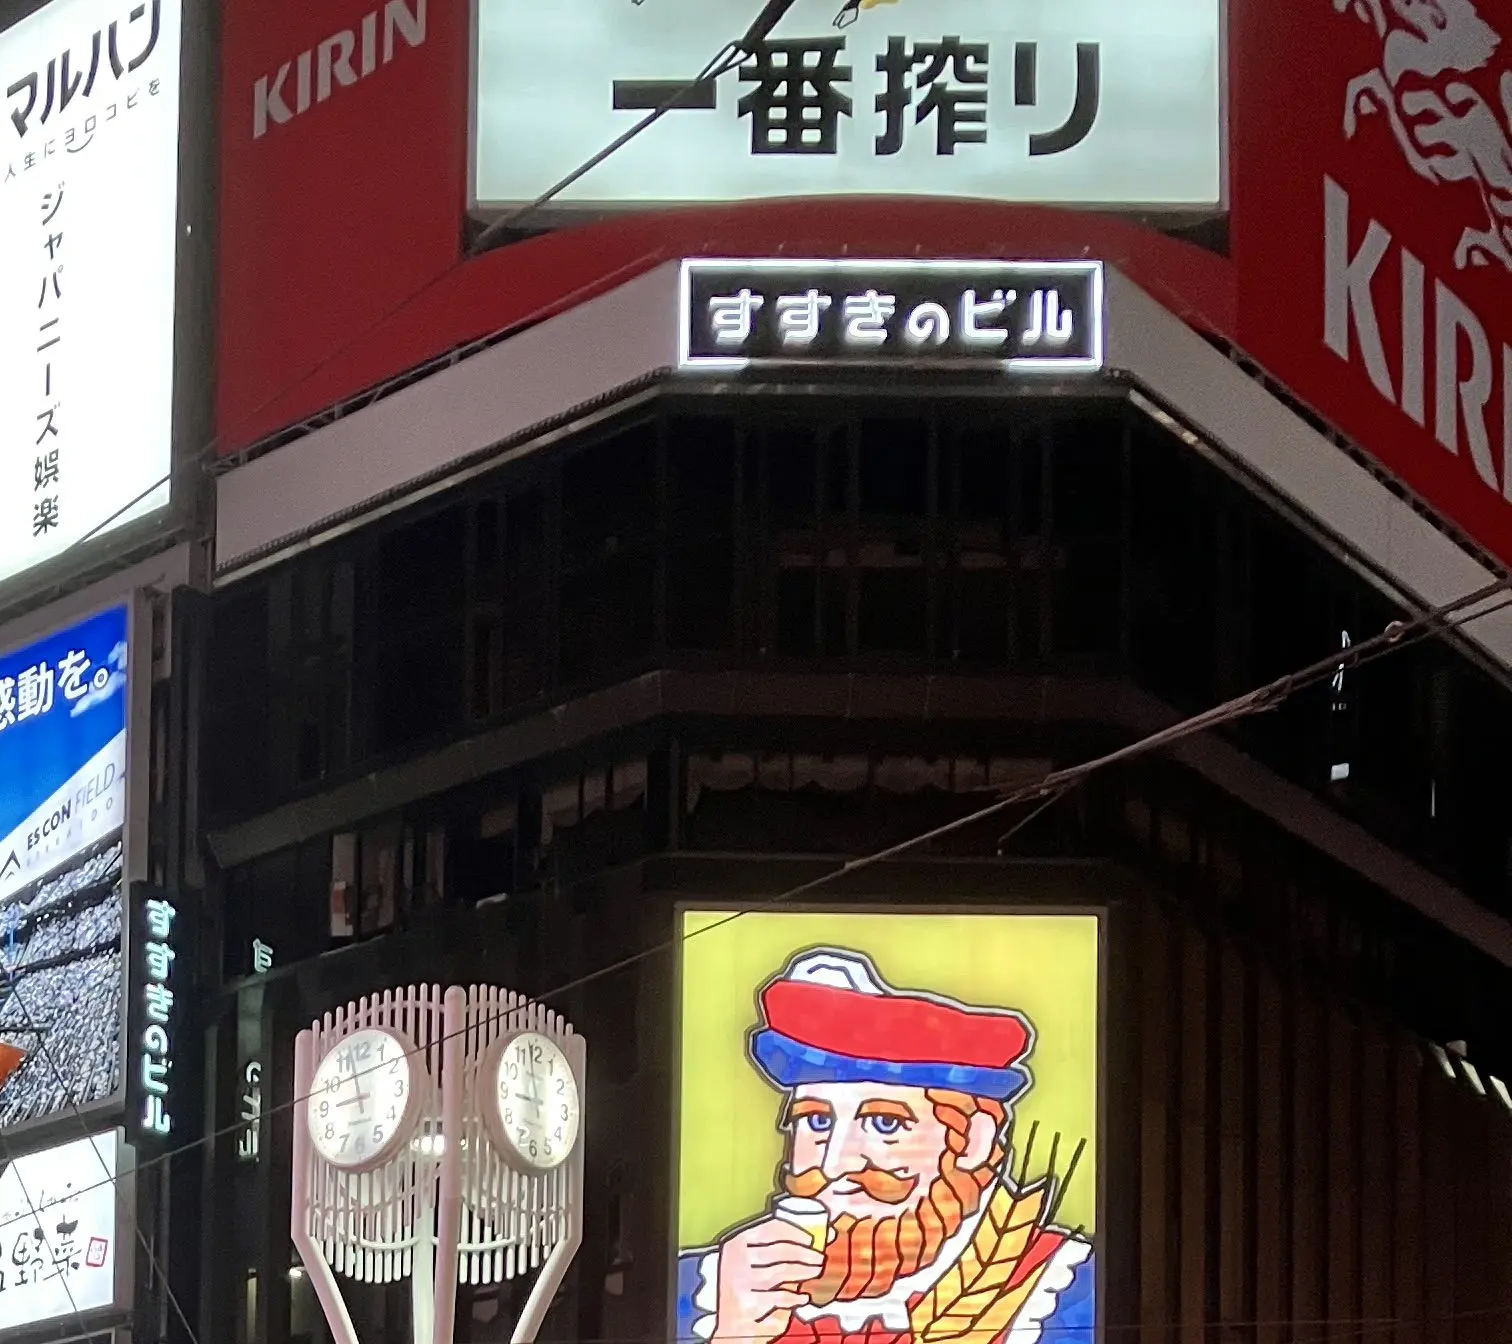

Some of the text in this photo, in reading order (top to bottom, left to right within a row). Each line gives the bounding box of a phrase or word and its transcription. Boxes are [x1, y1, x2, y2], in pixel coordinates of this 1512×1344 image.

[7, 0, 161, 138] マルハン
[252, 0, 429, 139] KIRIN
[611, 35, 1099, 156] 一番搾り
[4, 78, 161, 182] 人生にヨロコビを
[706, 287, 1075, 346] すすきのビル
[1323, 173, 1512, 505] KIR
[31, 181, 65, 538] ジャパニーズ娯楽
[74, 761, 116, 813] FIELD
[142, 899, 176, 1134] すすきのビル
[377, 1043, 385, 1061] 1
[389, 1058, 399, 1074] 2
[547, 1056, 554, 1076] 1
[395, 1080, 403, 1097] 3
[500, 1081, 509, 1099] 9
[556, 1078, 565, 1095] 2
[319, 1101, 329, 1117] 9
[386, 1105, 396, 1120] 4
[504, 1107, 512, 1124] 8
[561, 1104, 569, 1121] 3
[325, 1123, 334, 1139] 8
[372, 1124, 383, 1143] 5
[516, 1129, 526, 1147] 7
[554, 1126, 562, 1142] 4
[339, 1135, 349, 1152] 7
[354, 1134, 364, 1151] 6
[529, 1138, 537, 1156] 6
[544, 1137, 552, 1156] 5
